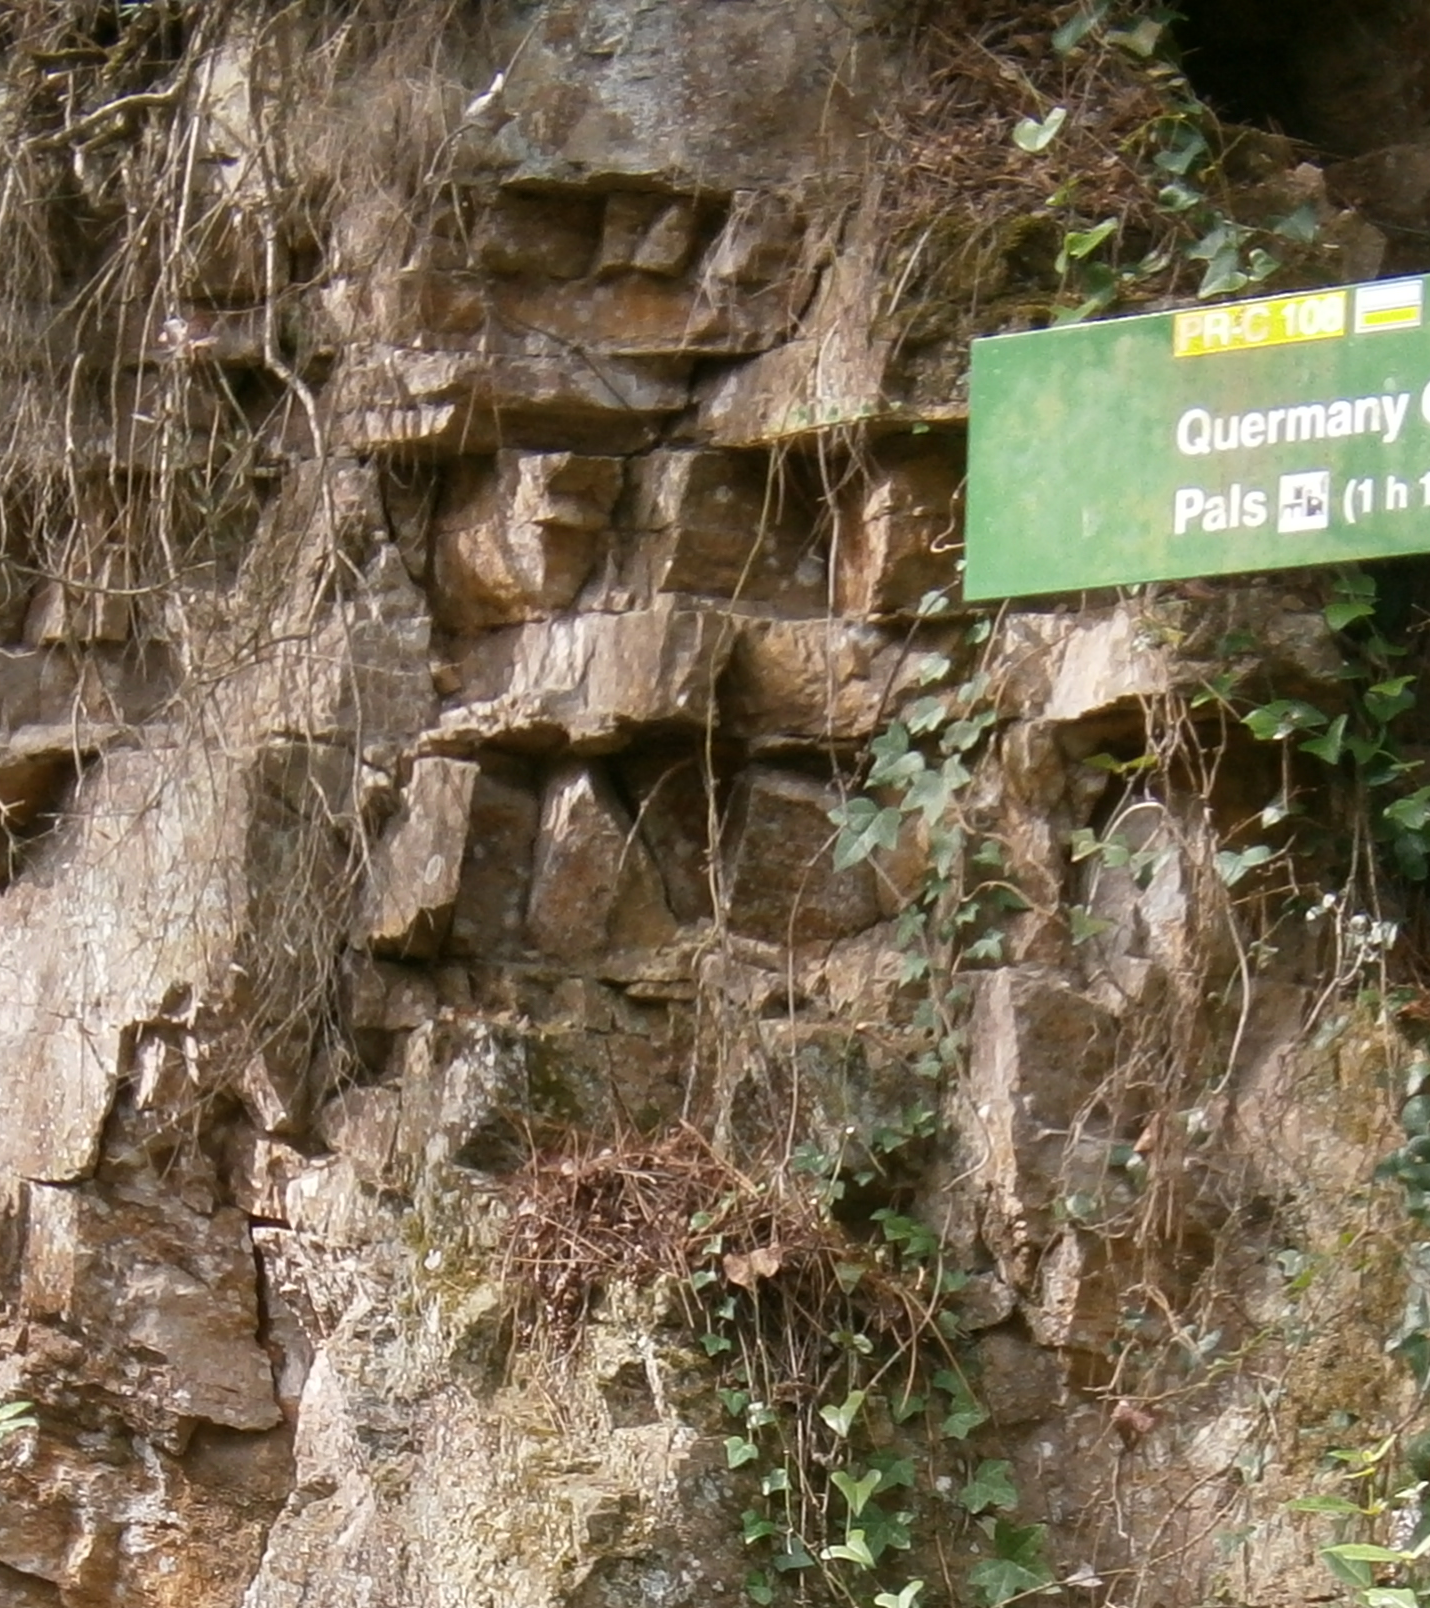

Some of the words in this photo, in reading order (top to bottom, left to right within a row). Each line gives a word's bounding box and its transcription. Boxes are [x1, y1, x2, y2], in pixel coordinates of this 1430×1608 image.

[1174, 305, 1271, 352] PR-C
[1177, 391, 1409, 455] Quermany
[1174, 484, 1267, 535] Pals
[1343, 478, 1373, 523] (1
[1386, 475, 1407, 510] h
